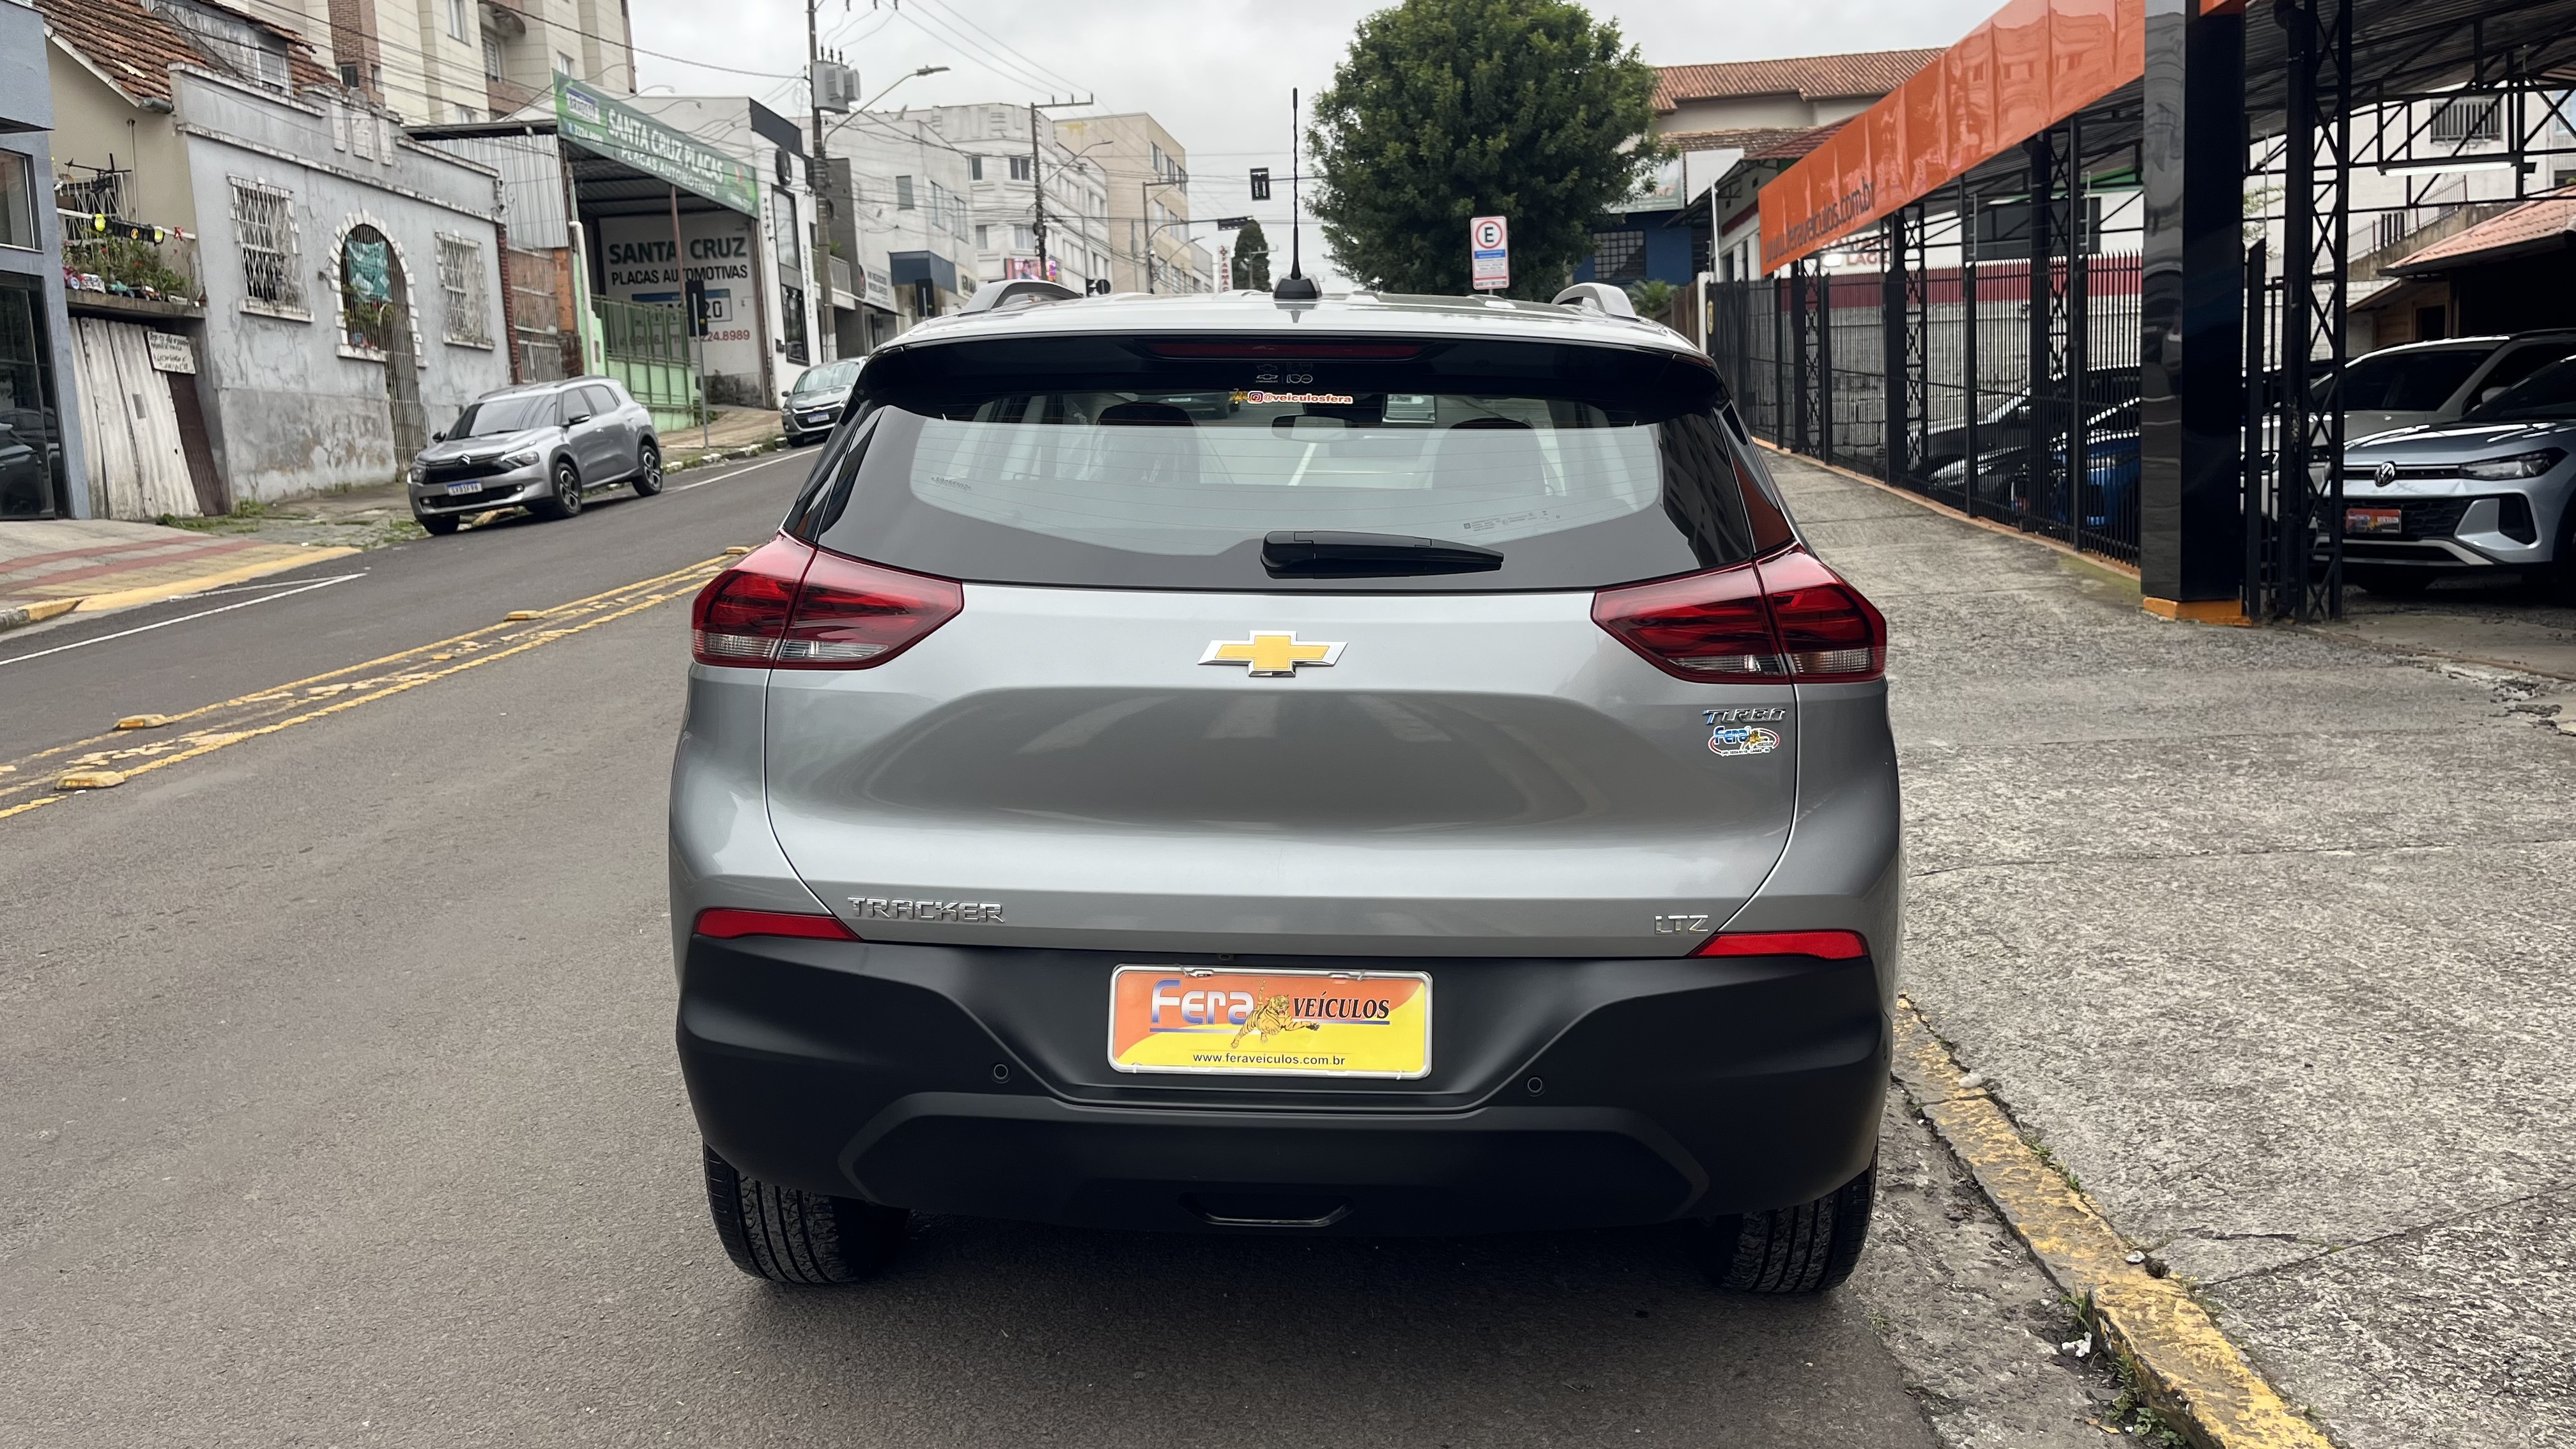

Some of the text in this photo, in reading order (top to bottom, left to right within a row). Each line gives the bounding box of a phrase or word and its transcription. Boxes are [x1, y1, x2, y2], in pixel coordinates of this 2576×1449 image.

[608, 109, 724, 183] SANTA CRUZ PLACAS
[621, 146, 716, 195] PLACAS AUTOMOTIVAS
[1484, 227, 1494, 243] E
[609, 236, 747, 264] SANTA CRUZ
[611, 264, 748, 285] PLACAS AUOMOTIVAS
[1264, 393, 1352, 403] @veiculosfera
[1702, 707, 1786, 725] TURBO
[848, 896, 1005, 924] TRACKER
[1655, 914, 1709, 933] LTZ
[1150, 978, 1390, 1025] Fera VEÍCULOS
[1193, 1052, 1346, 1066] www.feraveiculos.com.br
